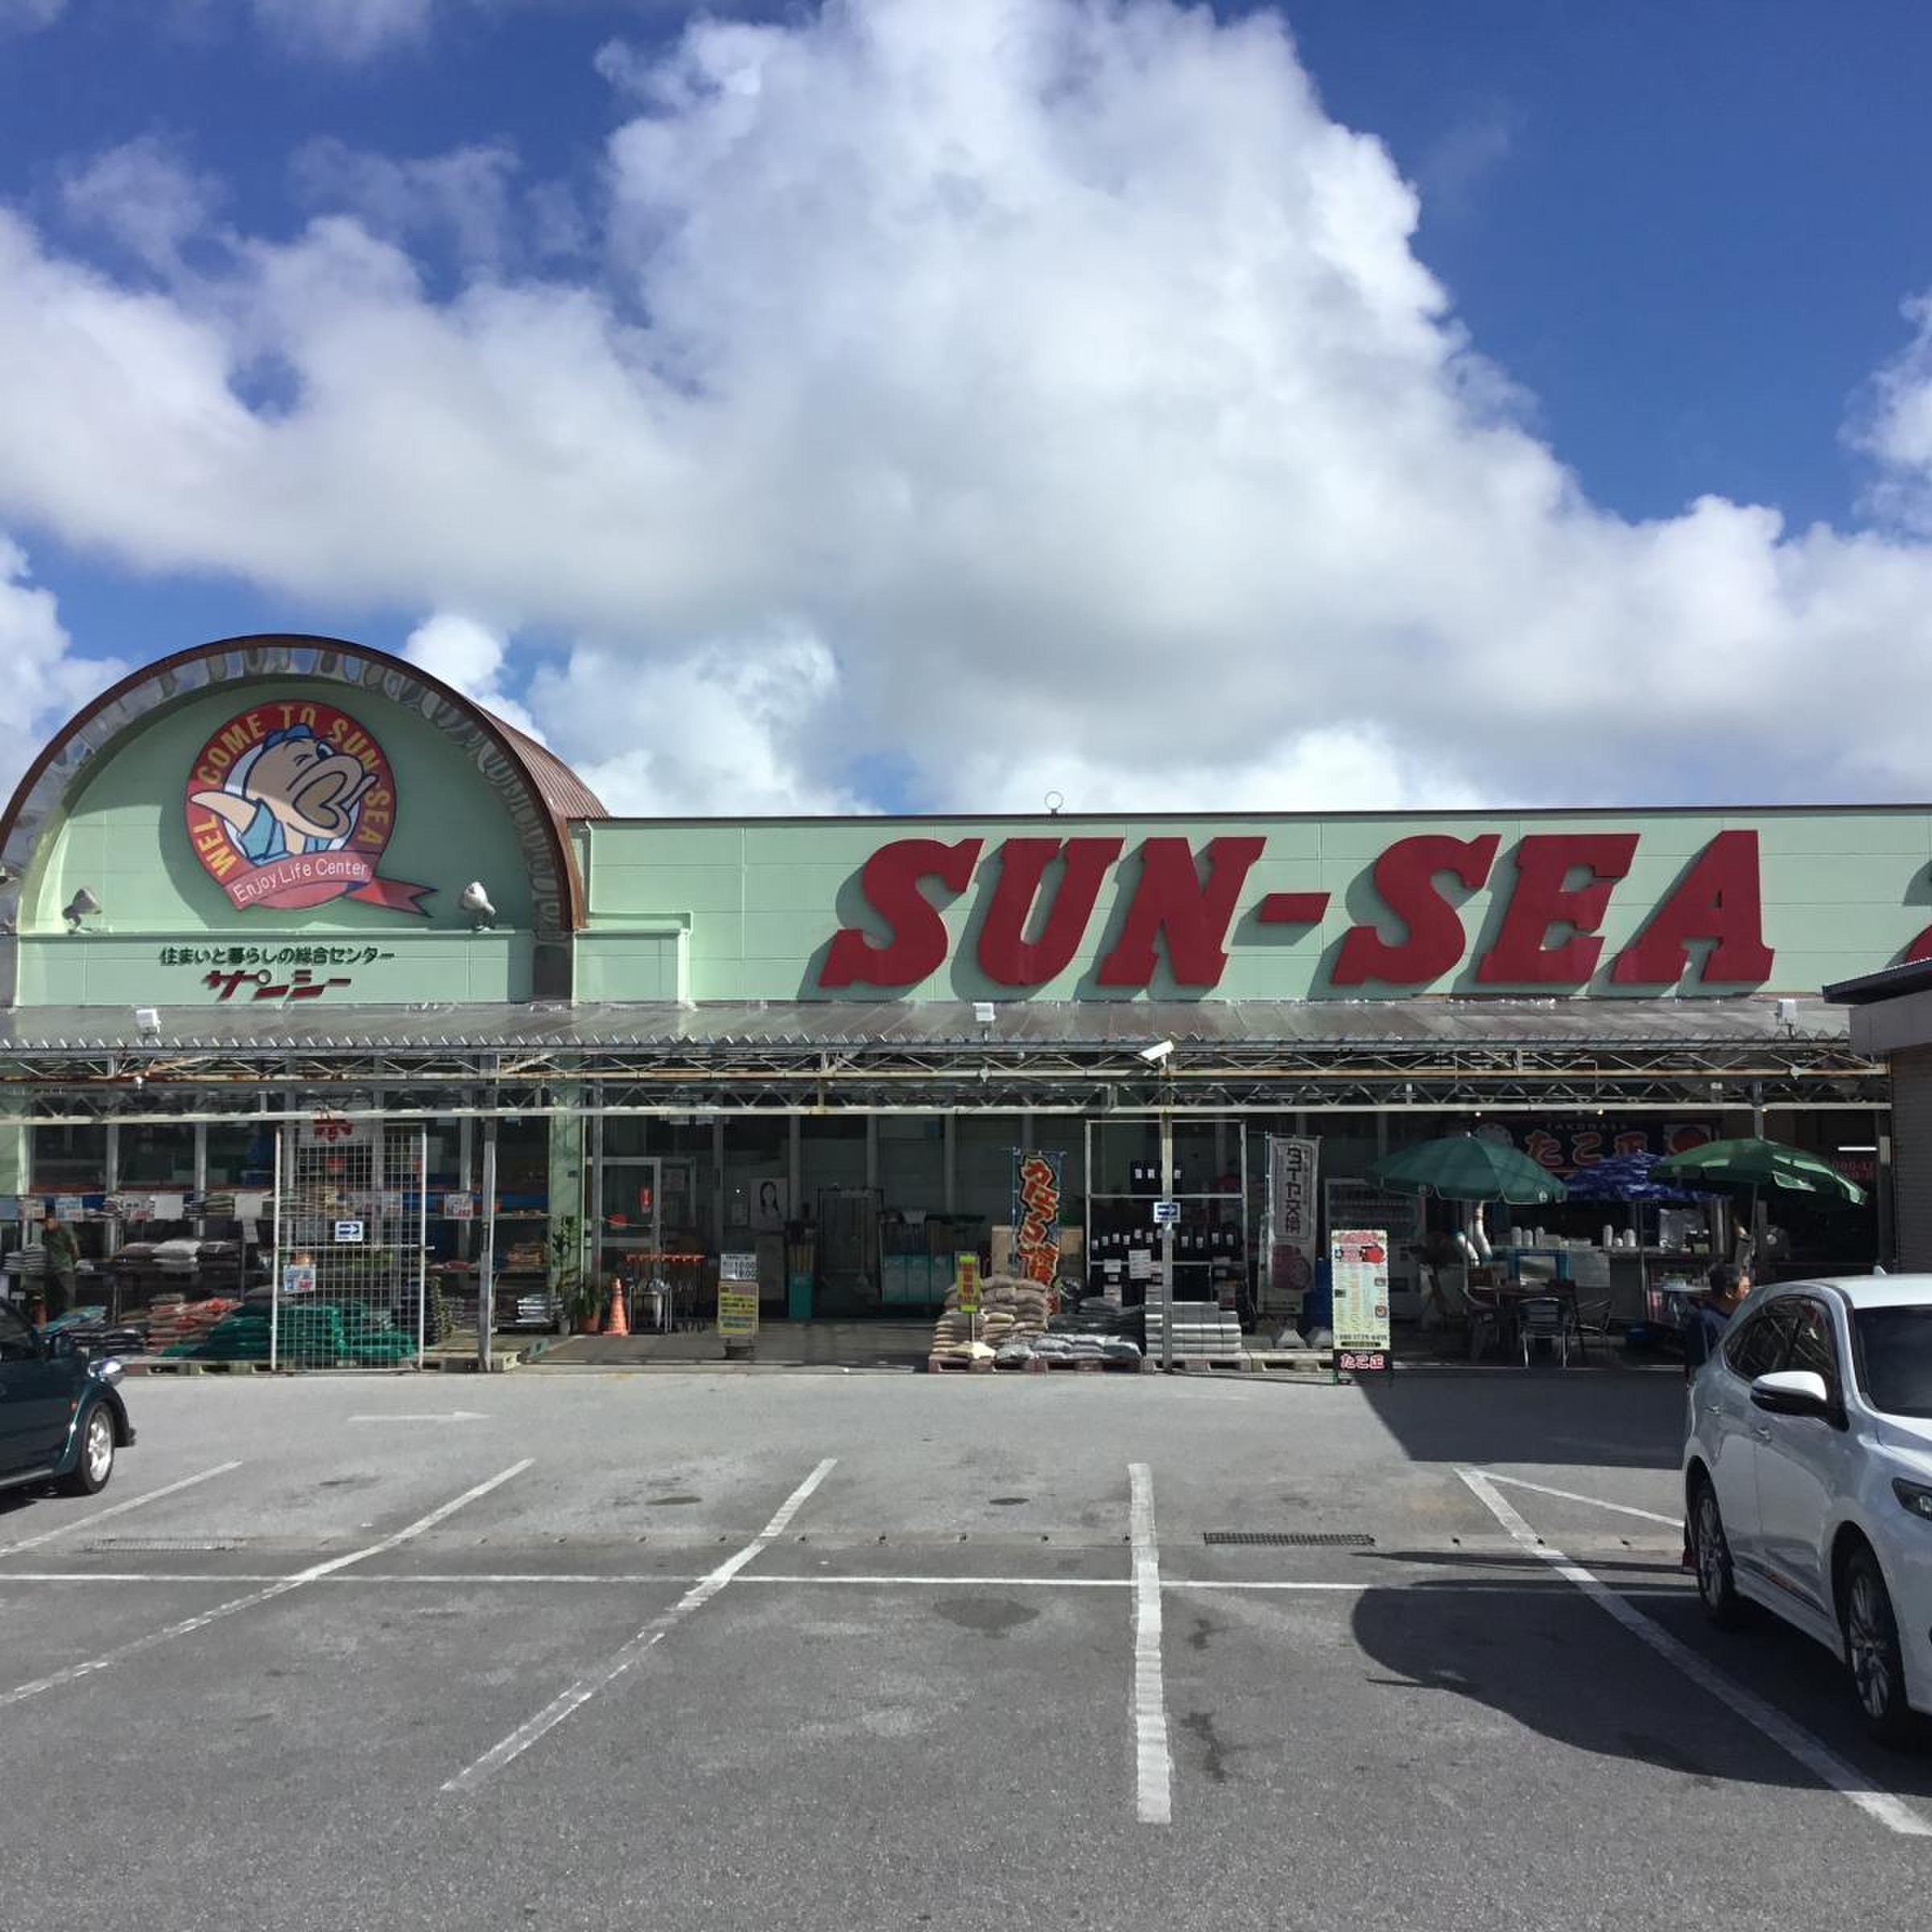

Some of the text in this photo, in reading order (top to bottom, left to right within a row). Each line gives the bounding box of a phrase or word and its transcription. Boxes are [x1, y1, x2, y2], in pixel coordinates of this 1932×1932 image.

[192, 706, 390, 877] WEL COME TO SUN SEA
[233, 858, 367, 902] Enjoy Life Center
[819, 830, 1774, 987] SUN-SEA
[161, 947, 395, 964] 住まいと暮らしの総合センター
